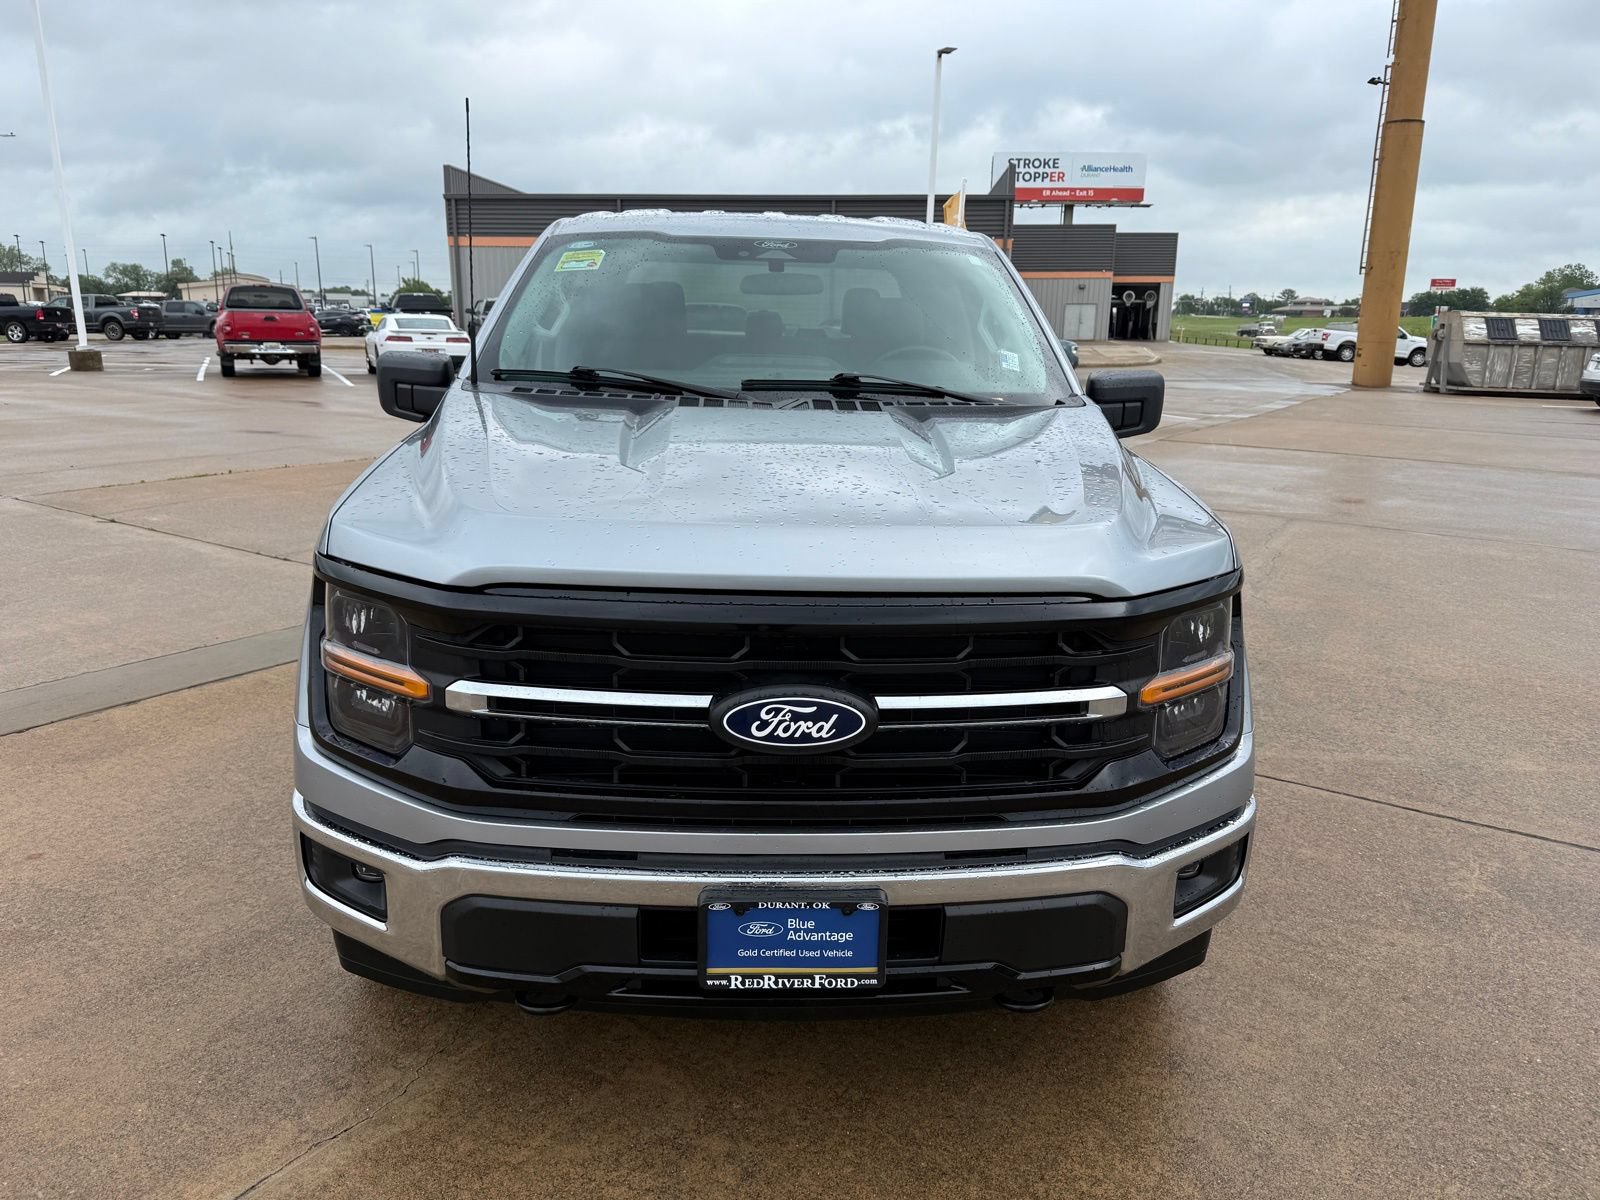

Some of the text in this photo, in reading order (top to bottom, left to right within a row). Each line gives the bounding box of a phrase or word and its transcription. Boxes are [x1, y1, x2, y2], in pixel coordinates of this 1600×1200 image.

[1080, 164, 1133, 172] AllianceHealth
[1015, 171, 1065, 182] TOPPER
[751, 704, 839, 738] Ford
[747, 924, 775, 935] Ford
[787, 919, 815, 929] Blue
[787, 931, 854, 942] Advantage
[738, 949, 853, 957] Gold Certified Used Vehicle
